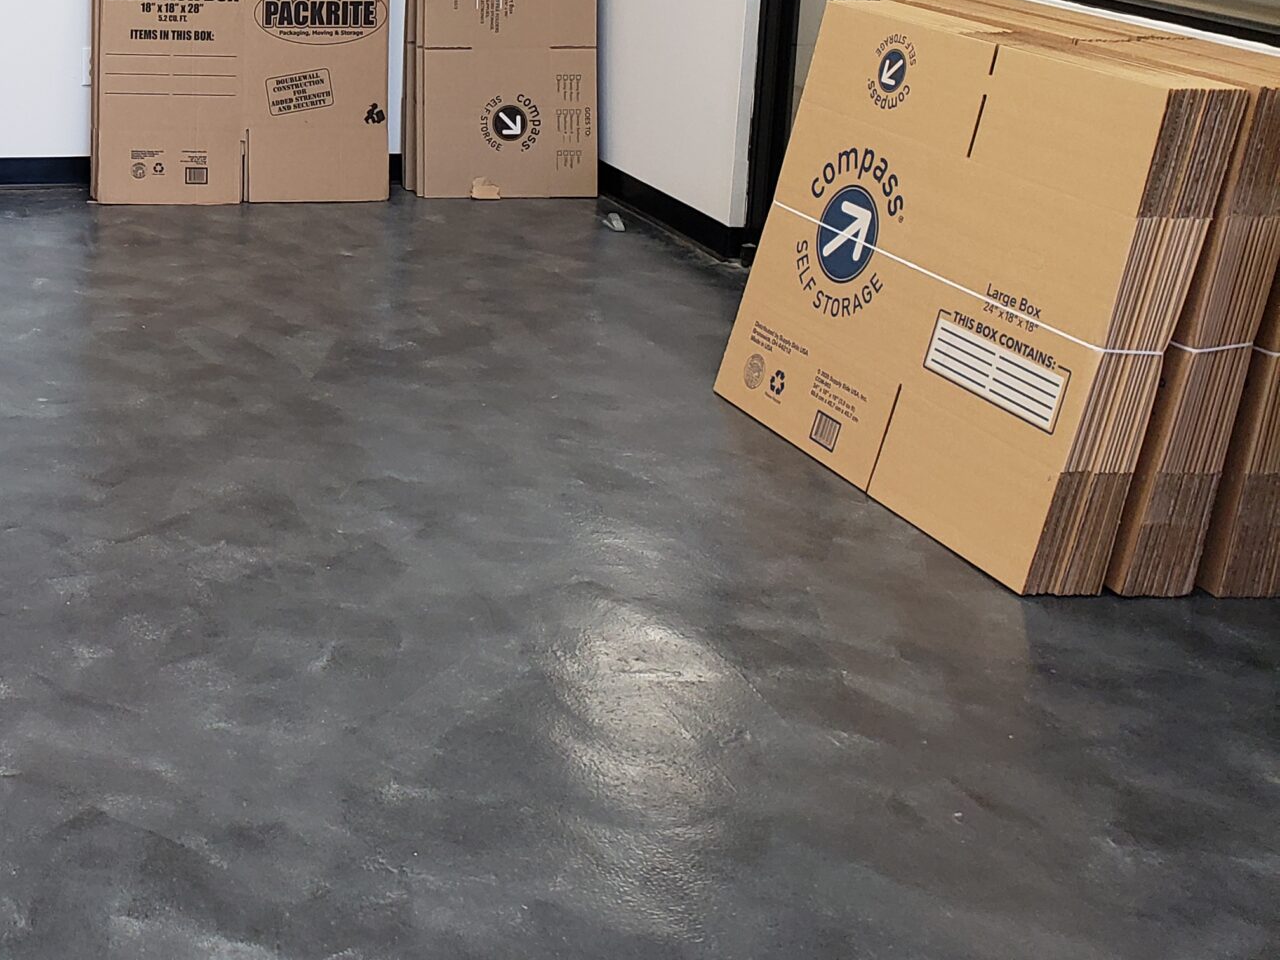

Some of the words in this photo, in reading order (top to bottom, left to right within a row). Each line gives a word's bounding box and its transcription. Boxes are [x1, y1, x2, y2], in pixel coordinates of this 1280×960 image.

[140, 2, 156, 13] 18"
[164, 3, 179, 13] 18"
[187, 3, 204, 14] 28"
[130, 29, 158, 40] ITEMS
[160, 30, 169, 40] IN
[171, 30, 192, 40] THIS
[193, 30, 215, 41] BOX:
[875, 33, 907, 57] STORAGE
[905, 42, 917, 66] SELF
[273, 79, 325, 93] CONSTRUCTION
[276, 72, 320, 86] DOUBLEWALL
[271, 98, 293, 107] ADDED
[295, 91, 331, 102] STRENGTH
[293, 99, 327, 110] SECURITY
[484, 95, 502, 115] SELF
[867, 79, 911, 109] compass
[480, 115, 503, 151] STORAGE
[517, 93, 541, 152] compass
[585, 127, 591, 136] TO
[811, 147, 904, 217] compass
[796, 240, 817, 291] SELF
[812, 273, 883, 318] STORAGE
[986, 282, 1017, 308] Large
[1019, 297, 1041, 319] Box
[983, 300, 999, 314] 24"
[1005, 310, 1018, 324] 18"
[1025, 320, 1039, 333] 18"
[953, 311, 976, 331] THIS
[975, 322, 999, 343] BOX
[998, 333, 1057, 370] CONTAINS:
